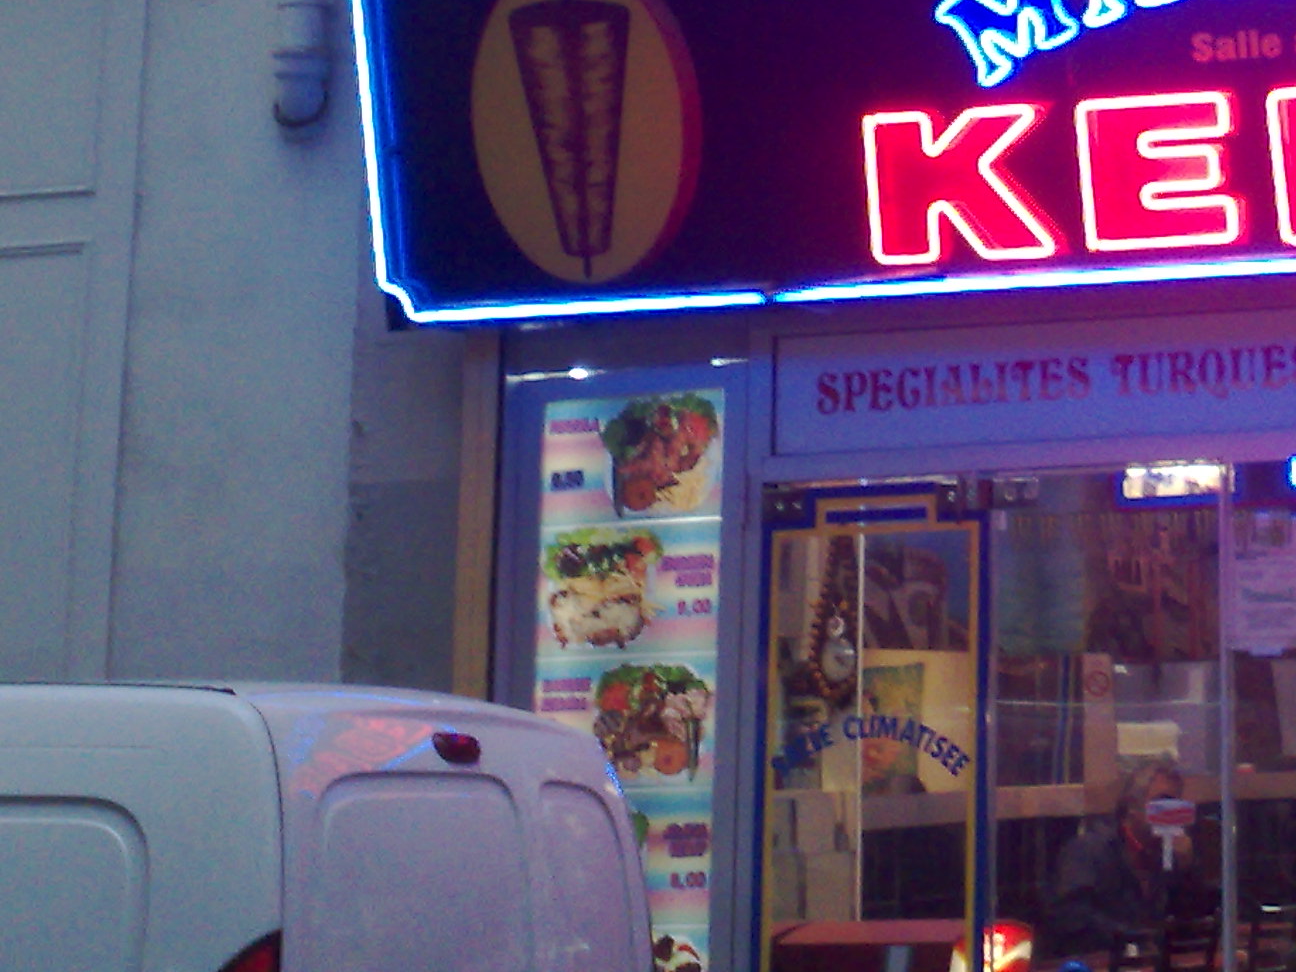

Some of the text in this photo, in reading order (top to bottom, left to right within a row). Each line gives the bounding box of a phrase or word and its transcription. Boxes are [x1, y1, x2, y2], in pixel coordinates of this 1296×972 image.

[1191, 29, 1283, 63] Salle
[815, 354, 1093, 416] SPECIALITES
[842, 714, 971, 777] CLIMATISEE
